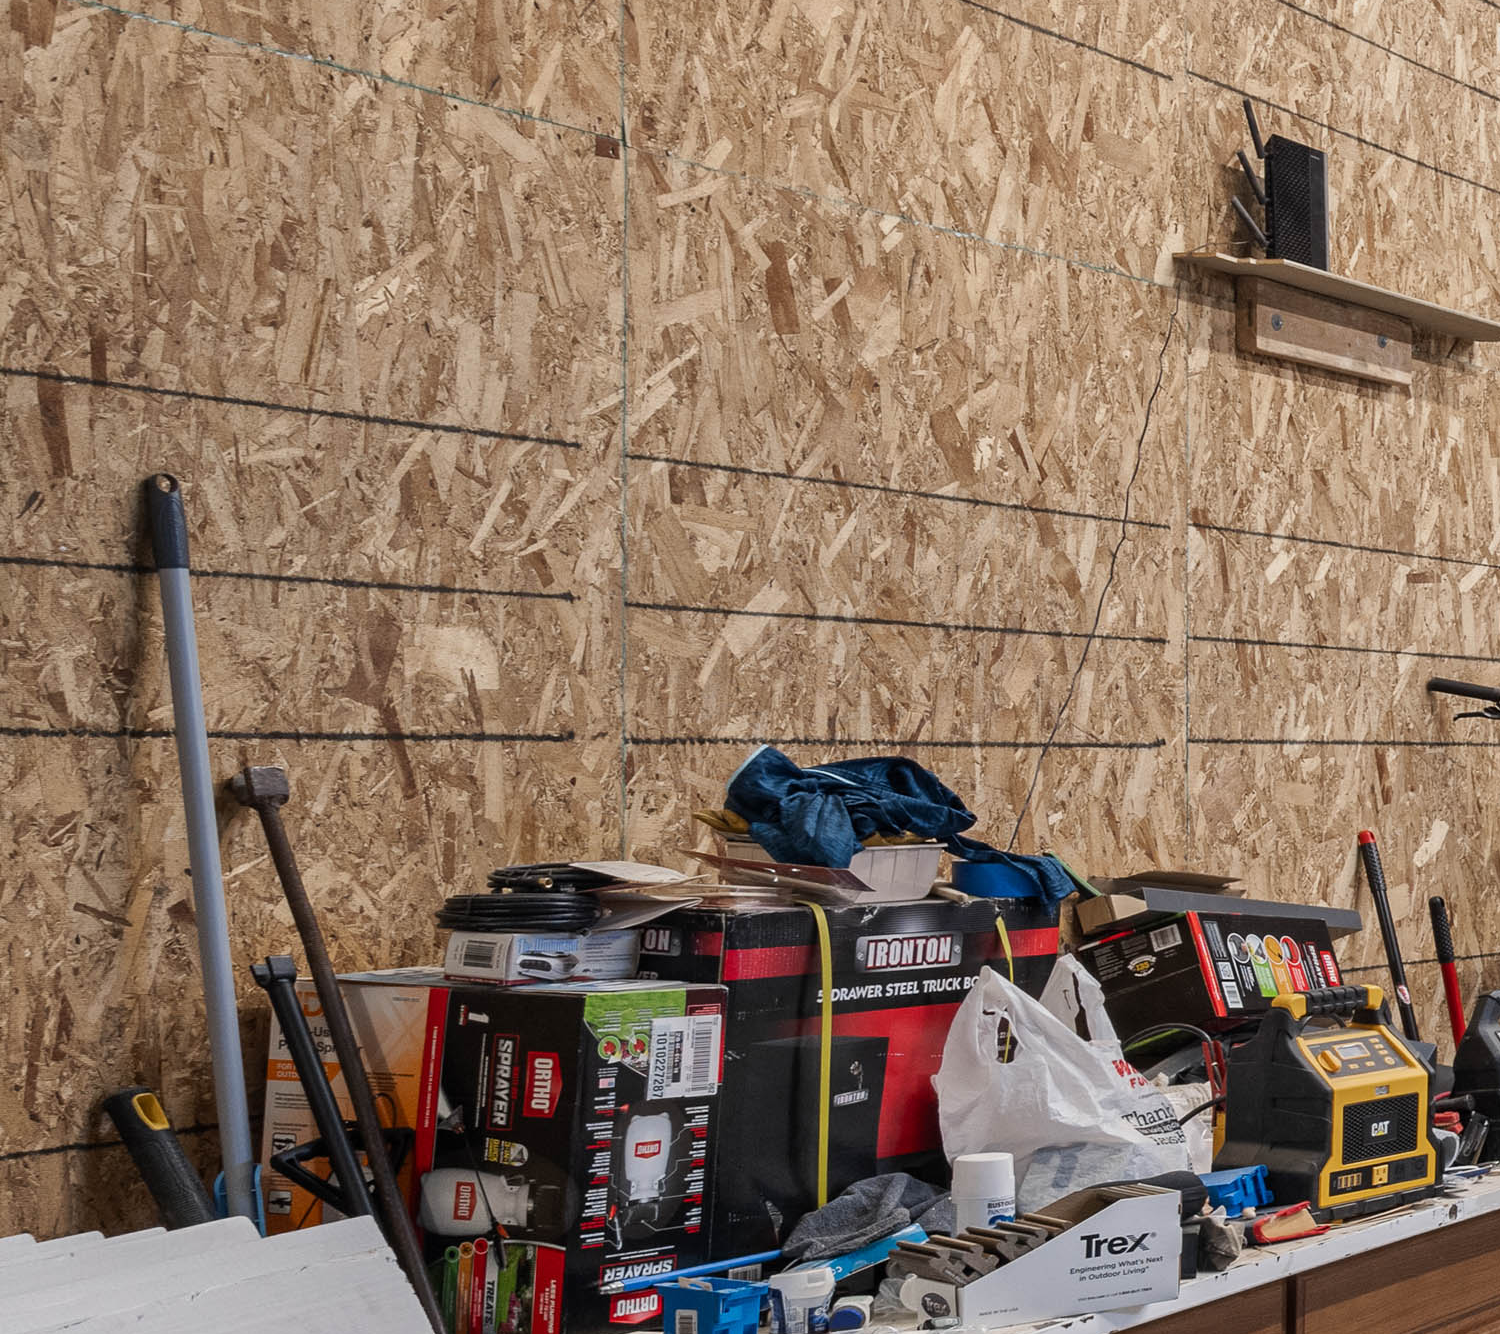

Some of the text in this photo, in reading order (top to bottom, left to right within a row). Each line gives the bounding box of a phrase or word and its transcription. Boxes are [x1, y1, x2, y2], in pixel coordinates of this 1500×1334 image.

[866, 936, 952, 970] IRONTON
[885, 982, 919, 997] STEEL
[923, 978, 961, 993] TRUCK
[492, 1039, 513, 1126] SPRAYER
[530, 1057, 553, 1111] ORTHO
[1371, 1120, 1390, 1137] CAT
[458, 1185, 472, 1218] ORTHO
[1080, 1233, 1149, 1259] Trex
[603, 1260, 673, 1282] SPRAYER
[1070, 1255, 1163, 1276] Engineering What's Next
[1088, 1270, 1121, 1280] Outdoor
[1123, 1267, 1145, 1277] Living
[484, 1280, 495, 1325] TREATS
[616, 1294, 658, 1317] ORTHO
[924, 1297, 947, 1314] Trex
